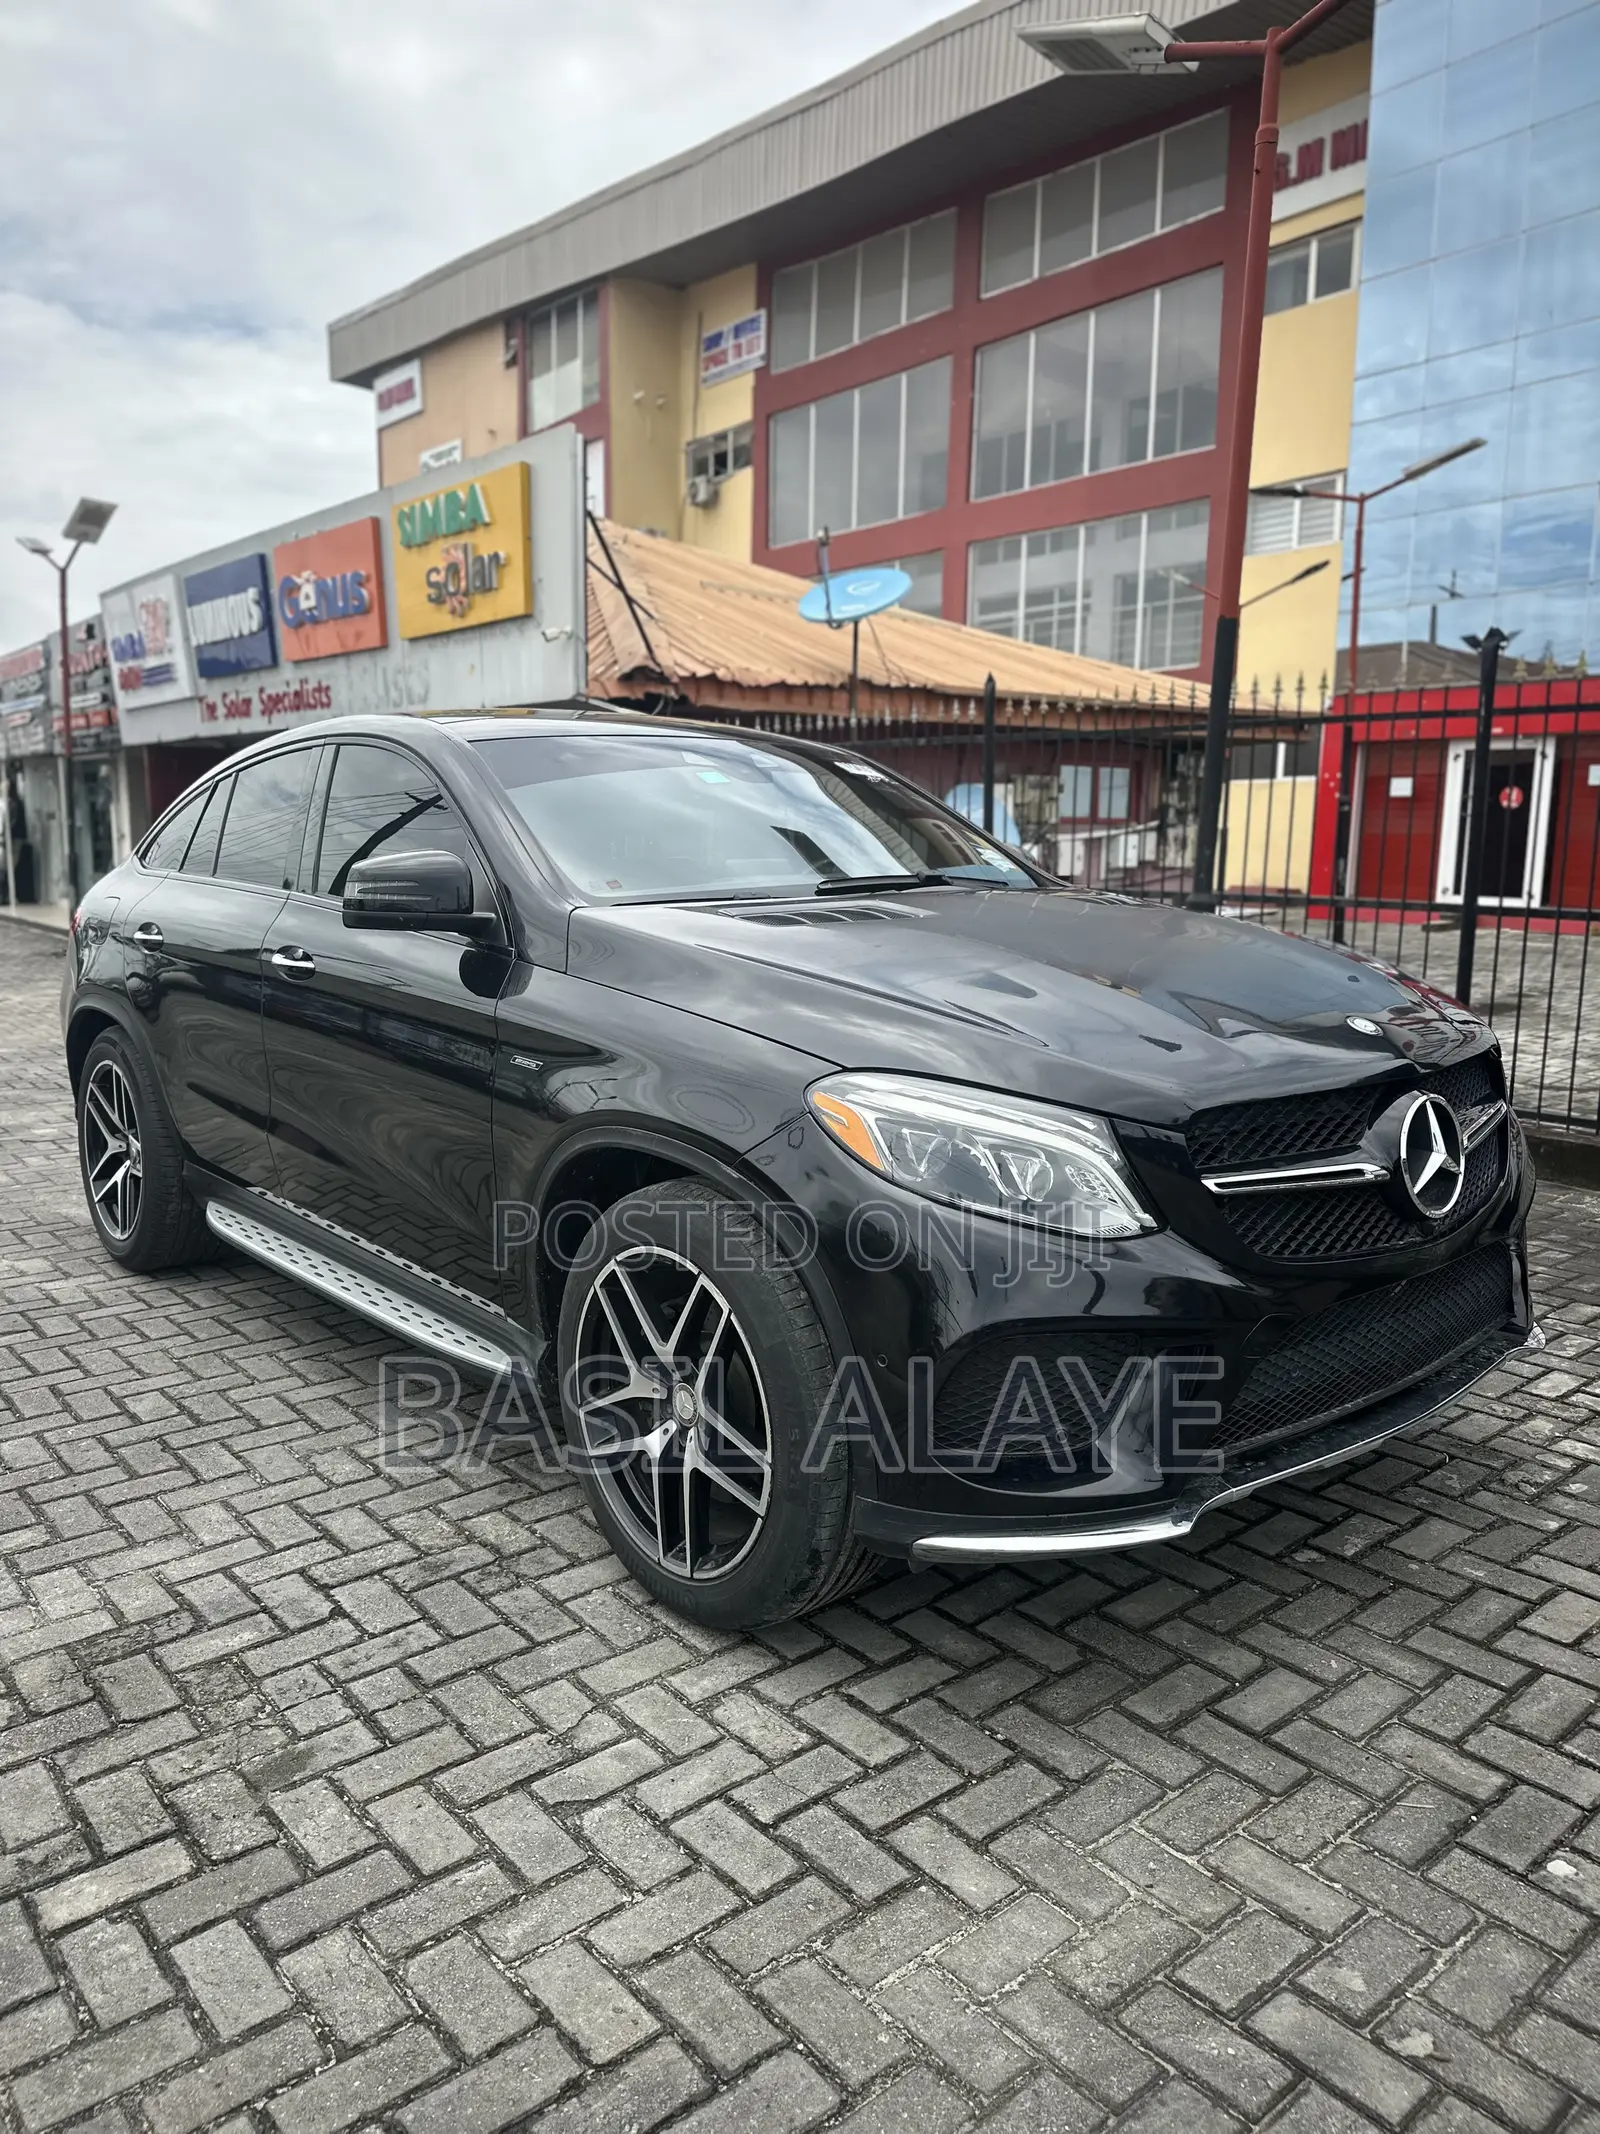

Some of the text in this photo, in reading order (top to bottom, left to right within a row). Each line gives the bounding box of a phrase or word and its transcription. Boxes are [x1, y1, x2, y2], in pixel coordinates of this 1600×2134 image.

[398, 483, 490, 549] SIMBA
[426, 543, 505, 605] solar
[198, 677, 332, 724] The Solar Specialists
